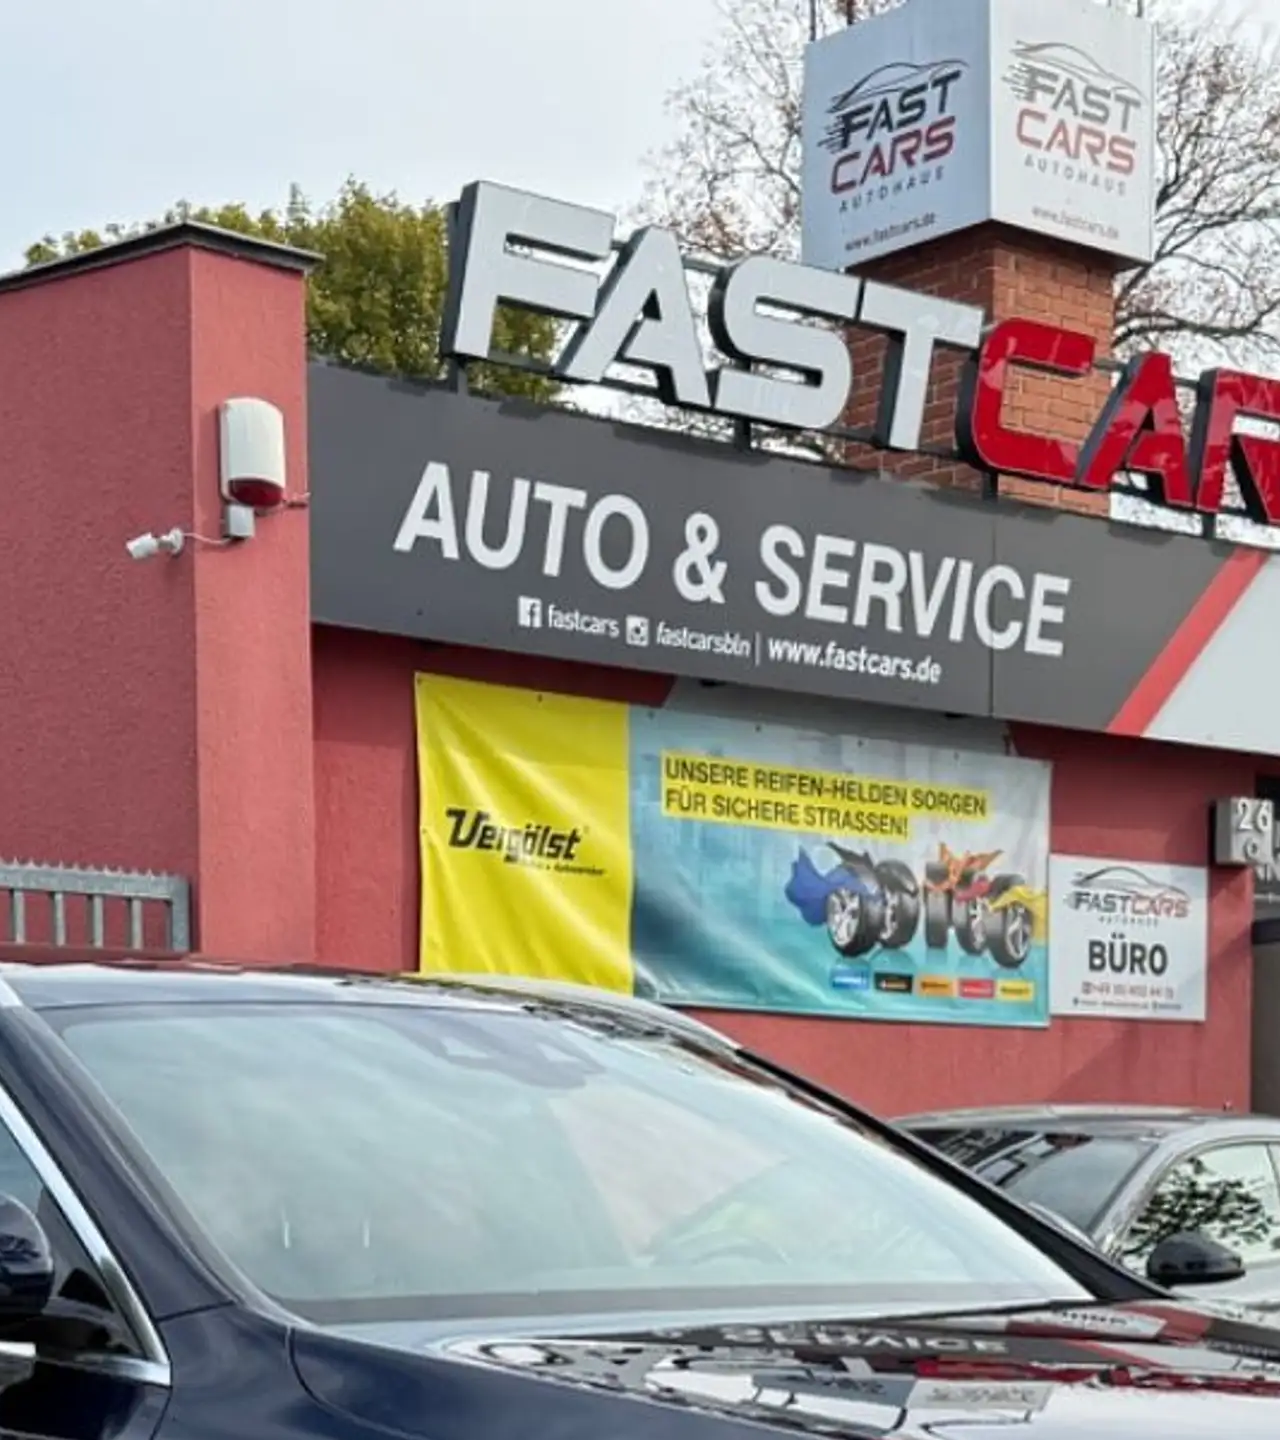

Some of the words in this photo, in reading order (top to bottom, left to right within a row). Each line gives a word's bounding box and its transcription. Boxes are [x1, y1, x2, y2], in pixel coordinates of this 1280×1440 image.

[838, 70, 962, 150] FAST
[1023, 67, 1141, 132] FAST
[831, 116, 956, 195] CARS
[1016, 108, 1137, 176] CARS
[839, 166, 945, 213] AUTOHAUS
[1024, 154, 1127, 197] AUTOHAUS
[393, 461, 649, 588] AUTO
[674, 512, 728, 603] &
[755, 524, 1071, 656] SERVICE
[548, 604, 620, 637] fastcars
[769, 639, 942, 684] www.fastcars.de
[666, 757, 749, 788] UNSERE
[754, 769, 907, 807] REIFEN-HELDEN
[911, 789, 986, 817] SORGEN
[666, 788, 707, 812] FÜR
[712, 794, 799, 825] SICHERE
[804, 806, 908, 836] STRASSEN!
[1238, 798, 1272, 832] 26
[1072, 890, 1190, 918] FASTCARS
[1088, 931, 1168, 975] BÜRO
